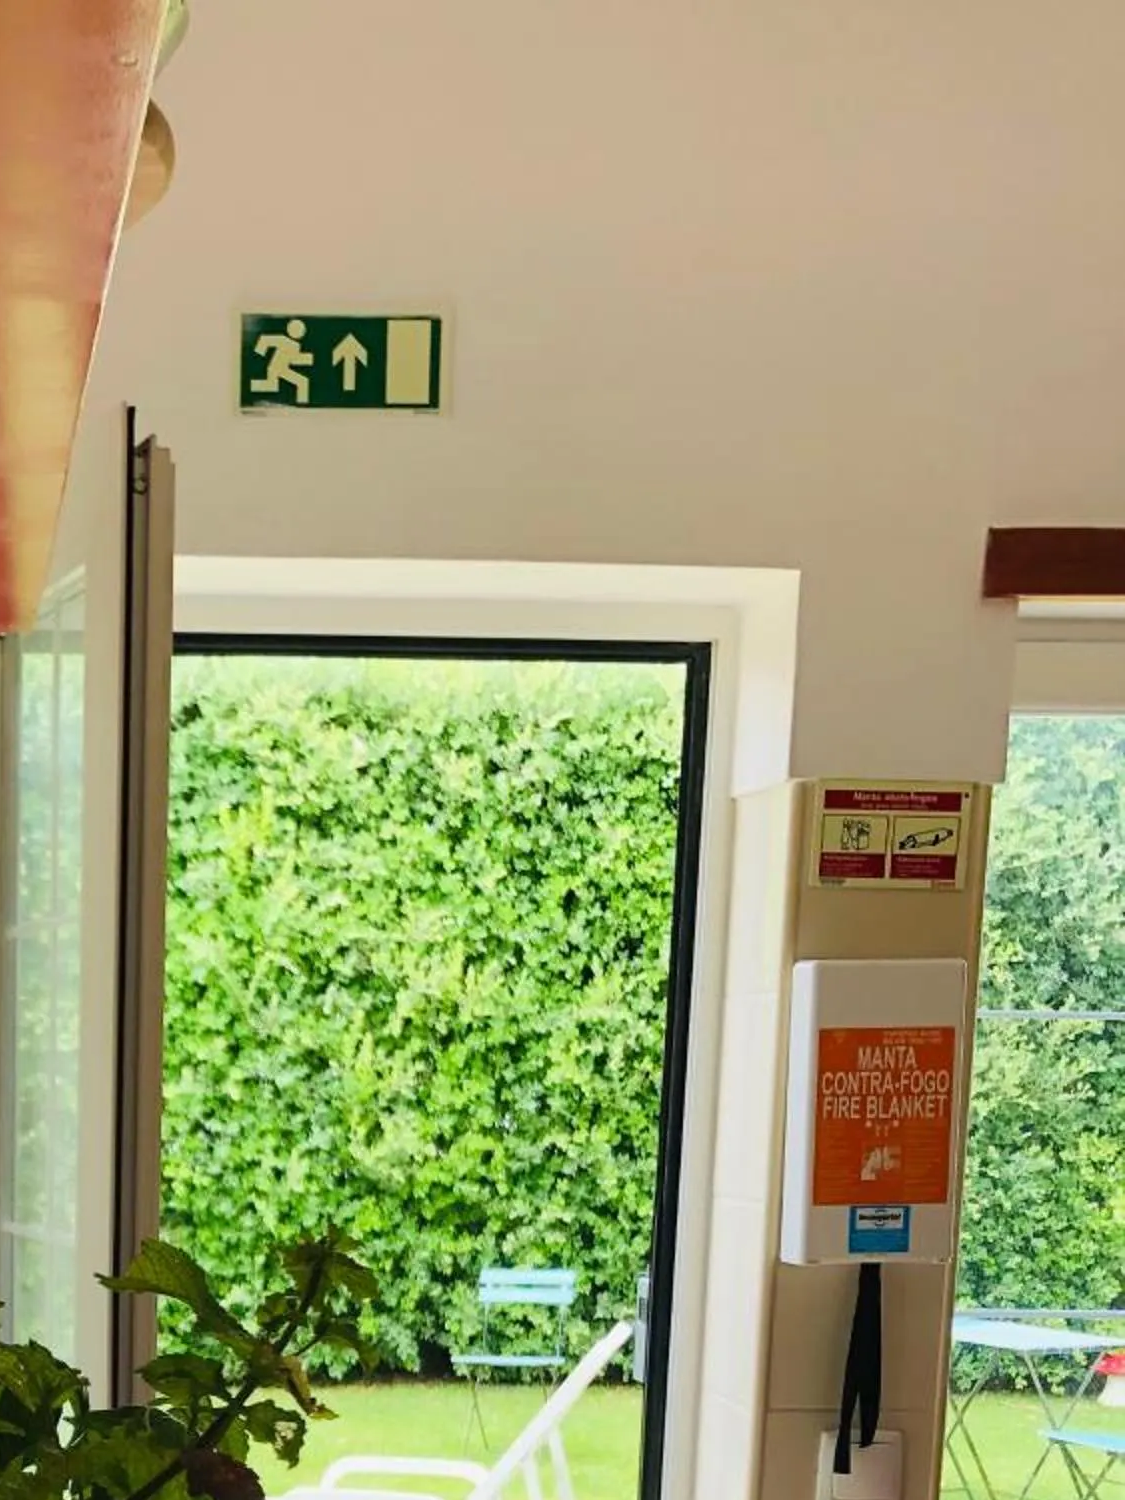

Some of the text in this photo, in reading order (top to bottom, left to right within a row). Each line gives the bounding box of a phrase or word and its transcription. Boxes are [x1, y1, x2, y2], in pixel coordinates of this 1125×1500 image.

[858, 1046, 917, 1070] MANTA
[822, 1070, 950, 1095] CONTRA-FOGO
[823, 1095, 947, 1119] FIRE BLANKET
